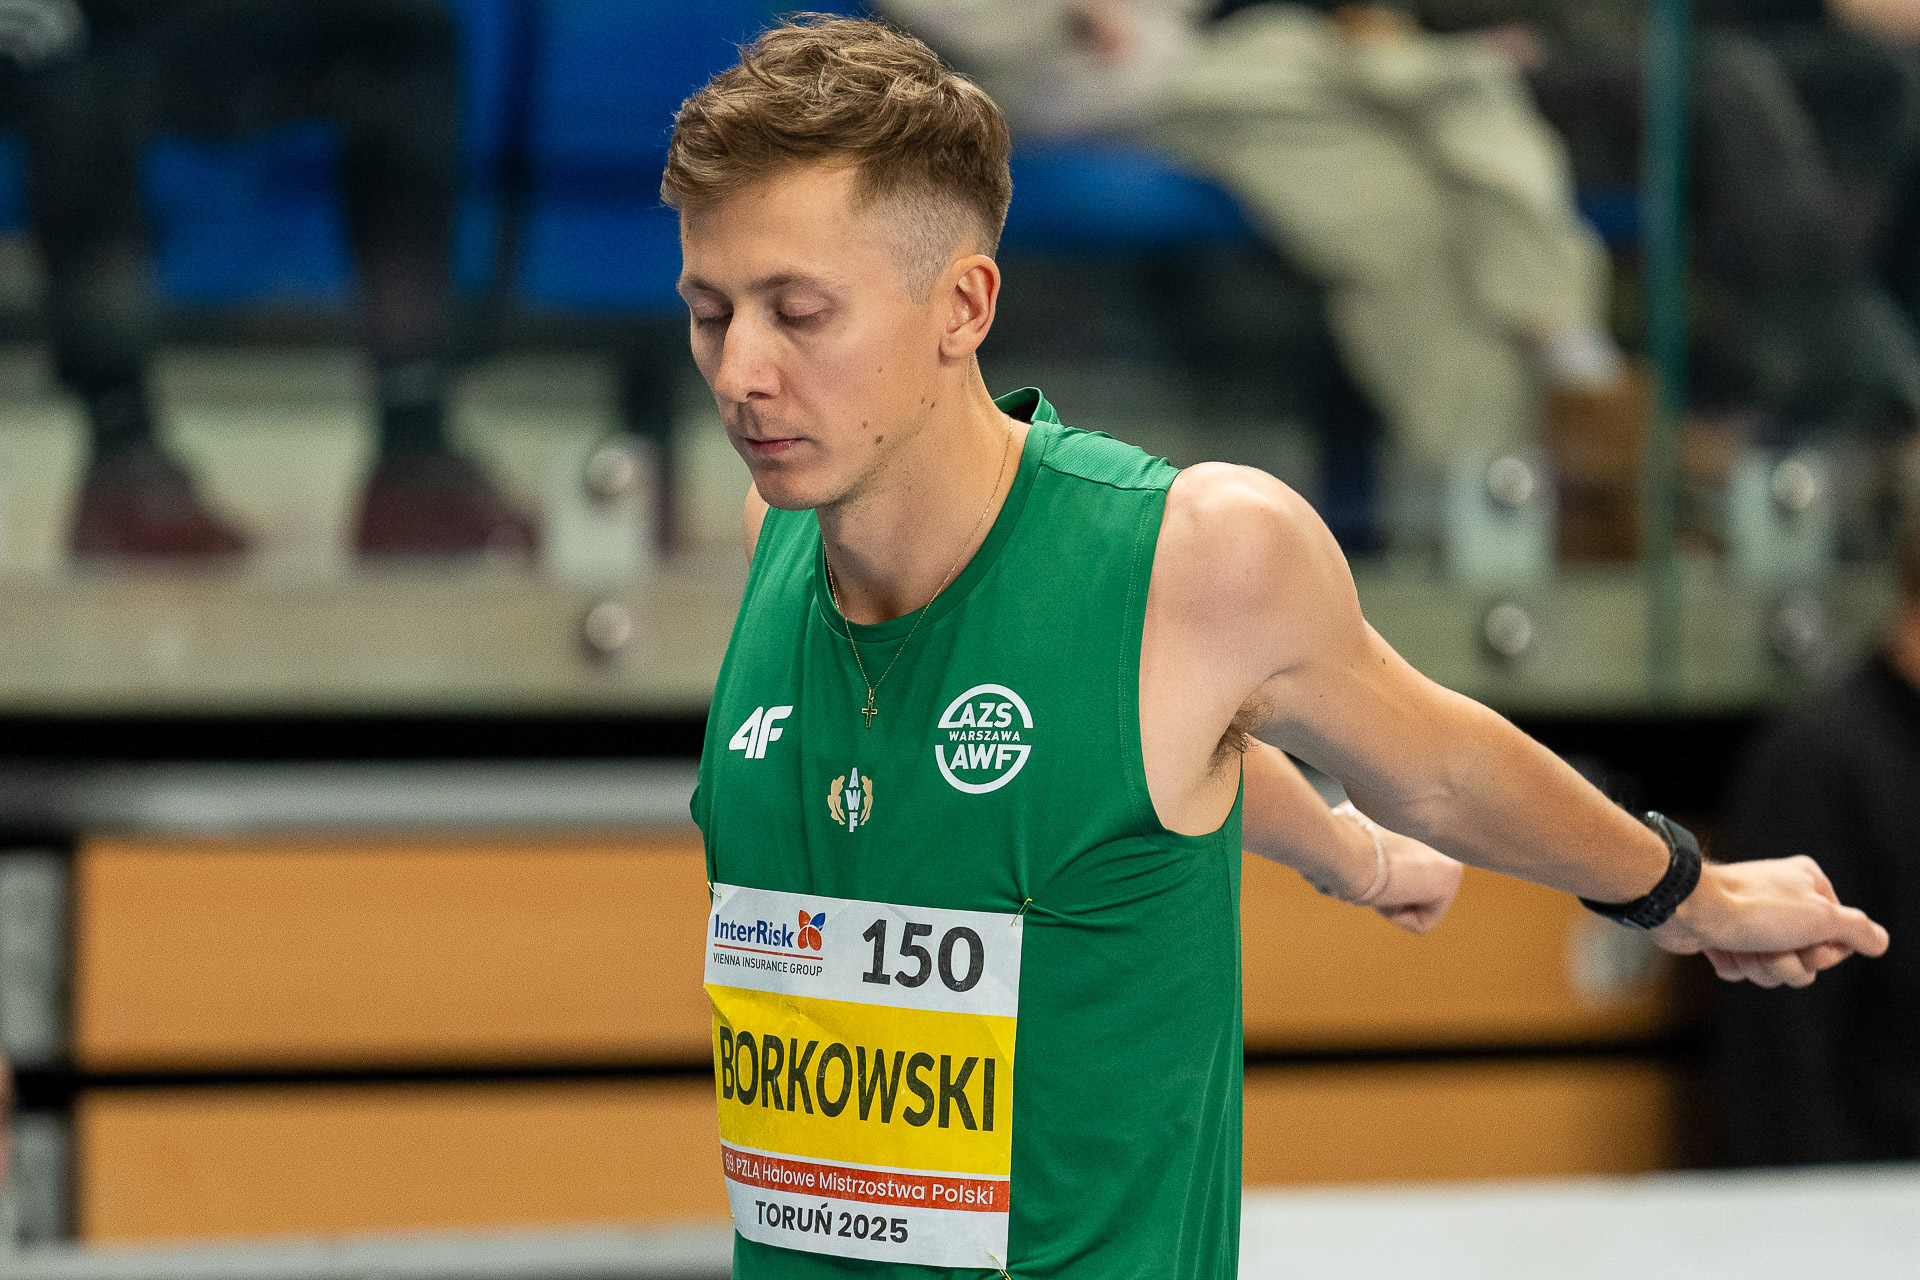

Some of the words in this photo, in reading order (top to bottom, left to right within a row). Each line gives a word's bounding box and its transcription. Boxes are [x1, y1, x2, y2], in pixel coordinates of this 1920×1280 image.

[729, 705, 793, 759] 4F
[957, 702, 1014, 728] AZS
[949, 730, 1021, 742] WARSZAWA
[949, 744, 1013, 770] AWF
[714, 914, 794, 949] InterRisk
[713, 953, 741, 967] VIENNA
[742, 957, 788, 973] INSURANCE
[789, 963, 823, 977] GROUP
[862, 918, 985, 992] 150
[719, 1025, 996, 1132] BORKOWSKI
[736, 1157, 760, 1179] PZLA
[762, 1163, 815, 1188] Halowe
[819, 1172, 925, 1200] Mistrzostwa
[932, 1183, 994, 1205] Polski
[756, 1200, 833, 1235] TORUŃ
[838, 1214, 908, 1243] 2025
